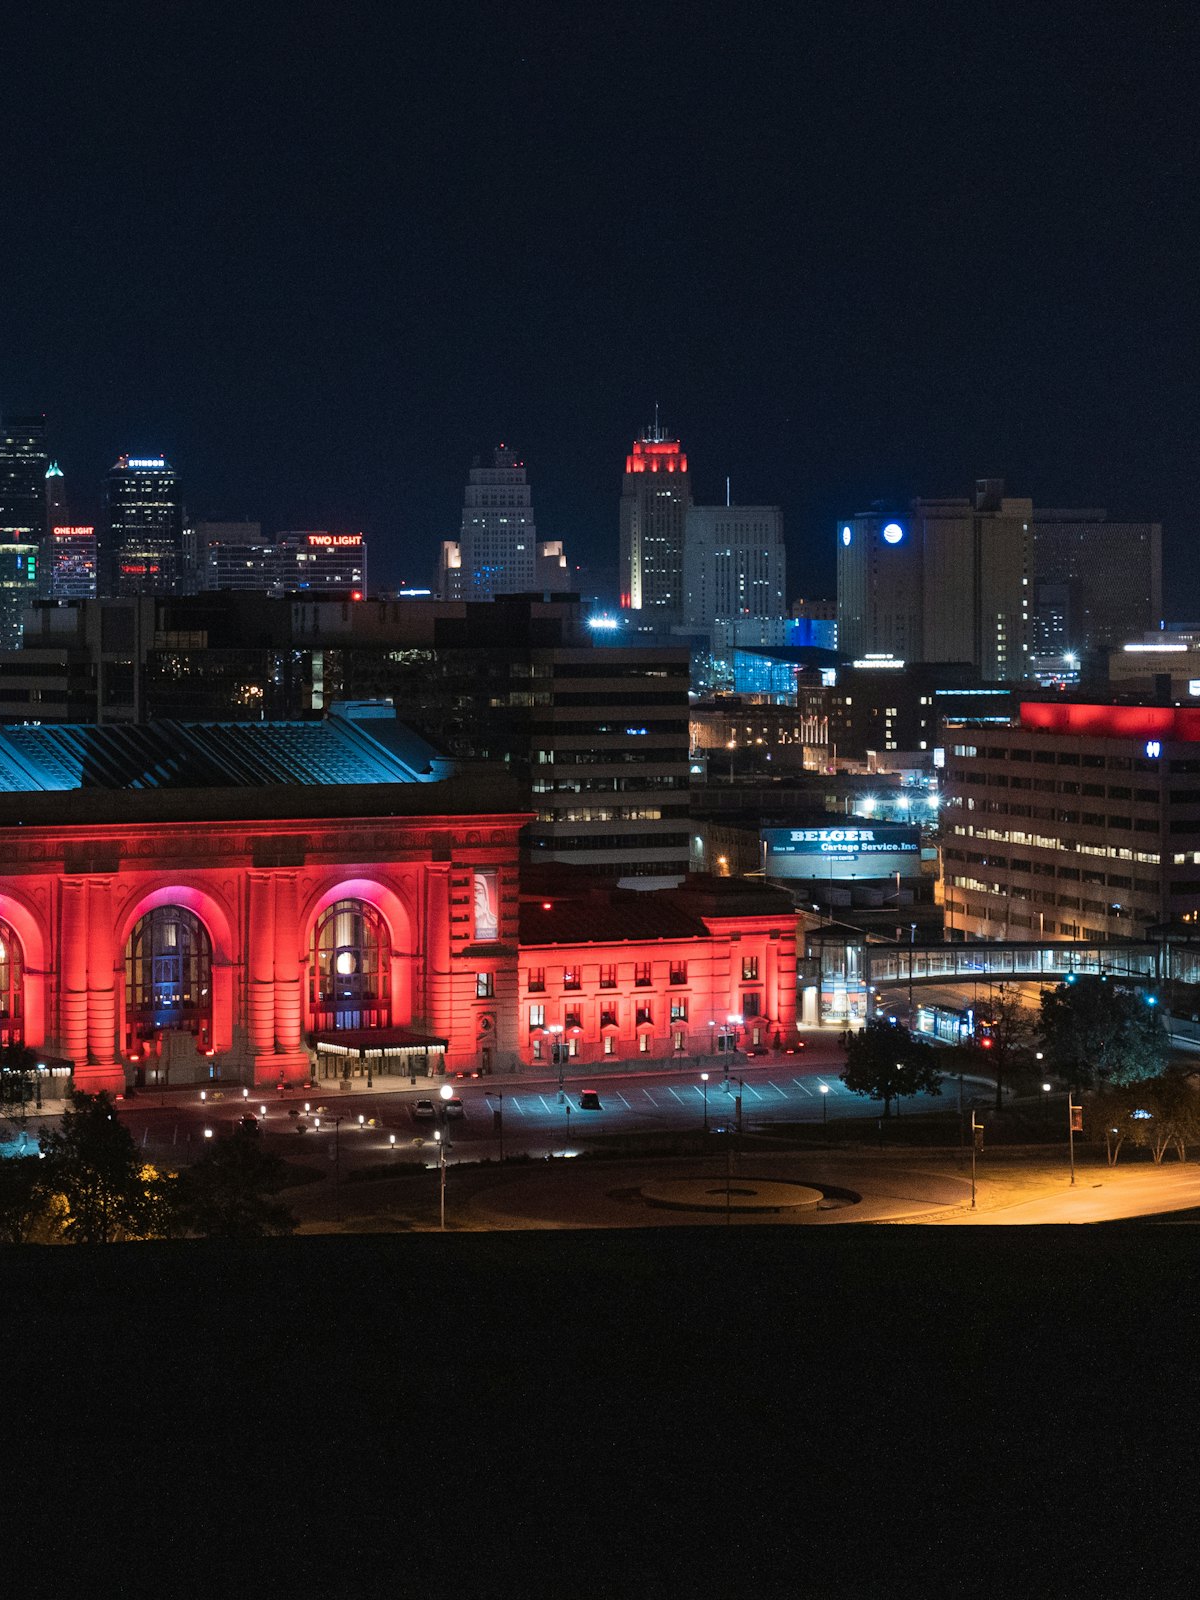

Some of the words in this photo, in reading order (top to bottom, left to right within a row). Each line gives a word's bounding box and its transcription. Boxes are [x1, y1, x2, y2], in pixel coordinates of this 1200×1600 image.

[54, 527, 71, 535] ONE
[71, 527, 94, 535] LIGHT
[309, 535, 332, 545] TWO
[333, 535, 362, 545] LIGHT
[790, 830, 875, 842] BELGER
[821, 842, 859, 853] Cartage
